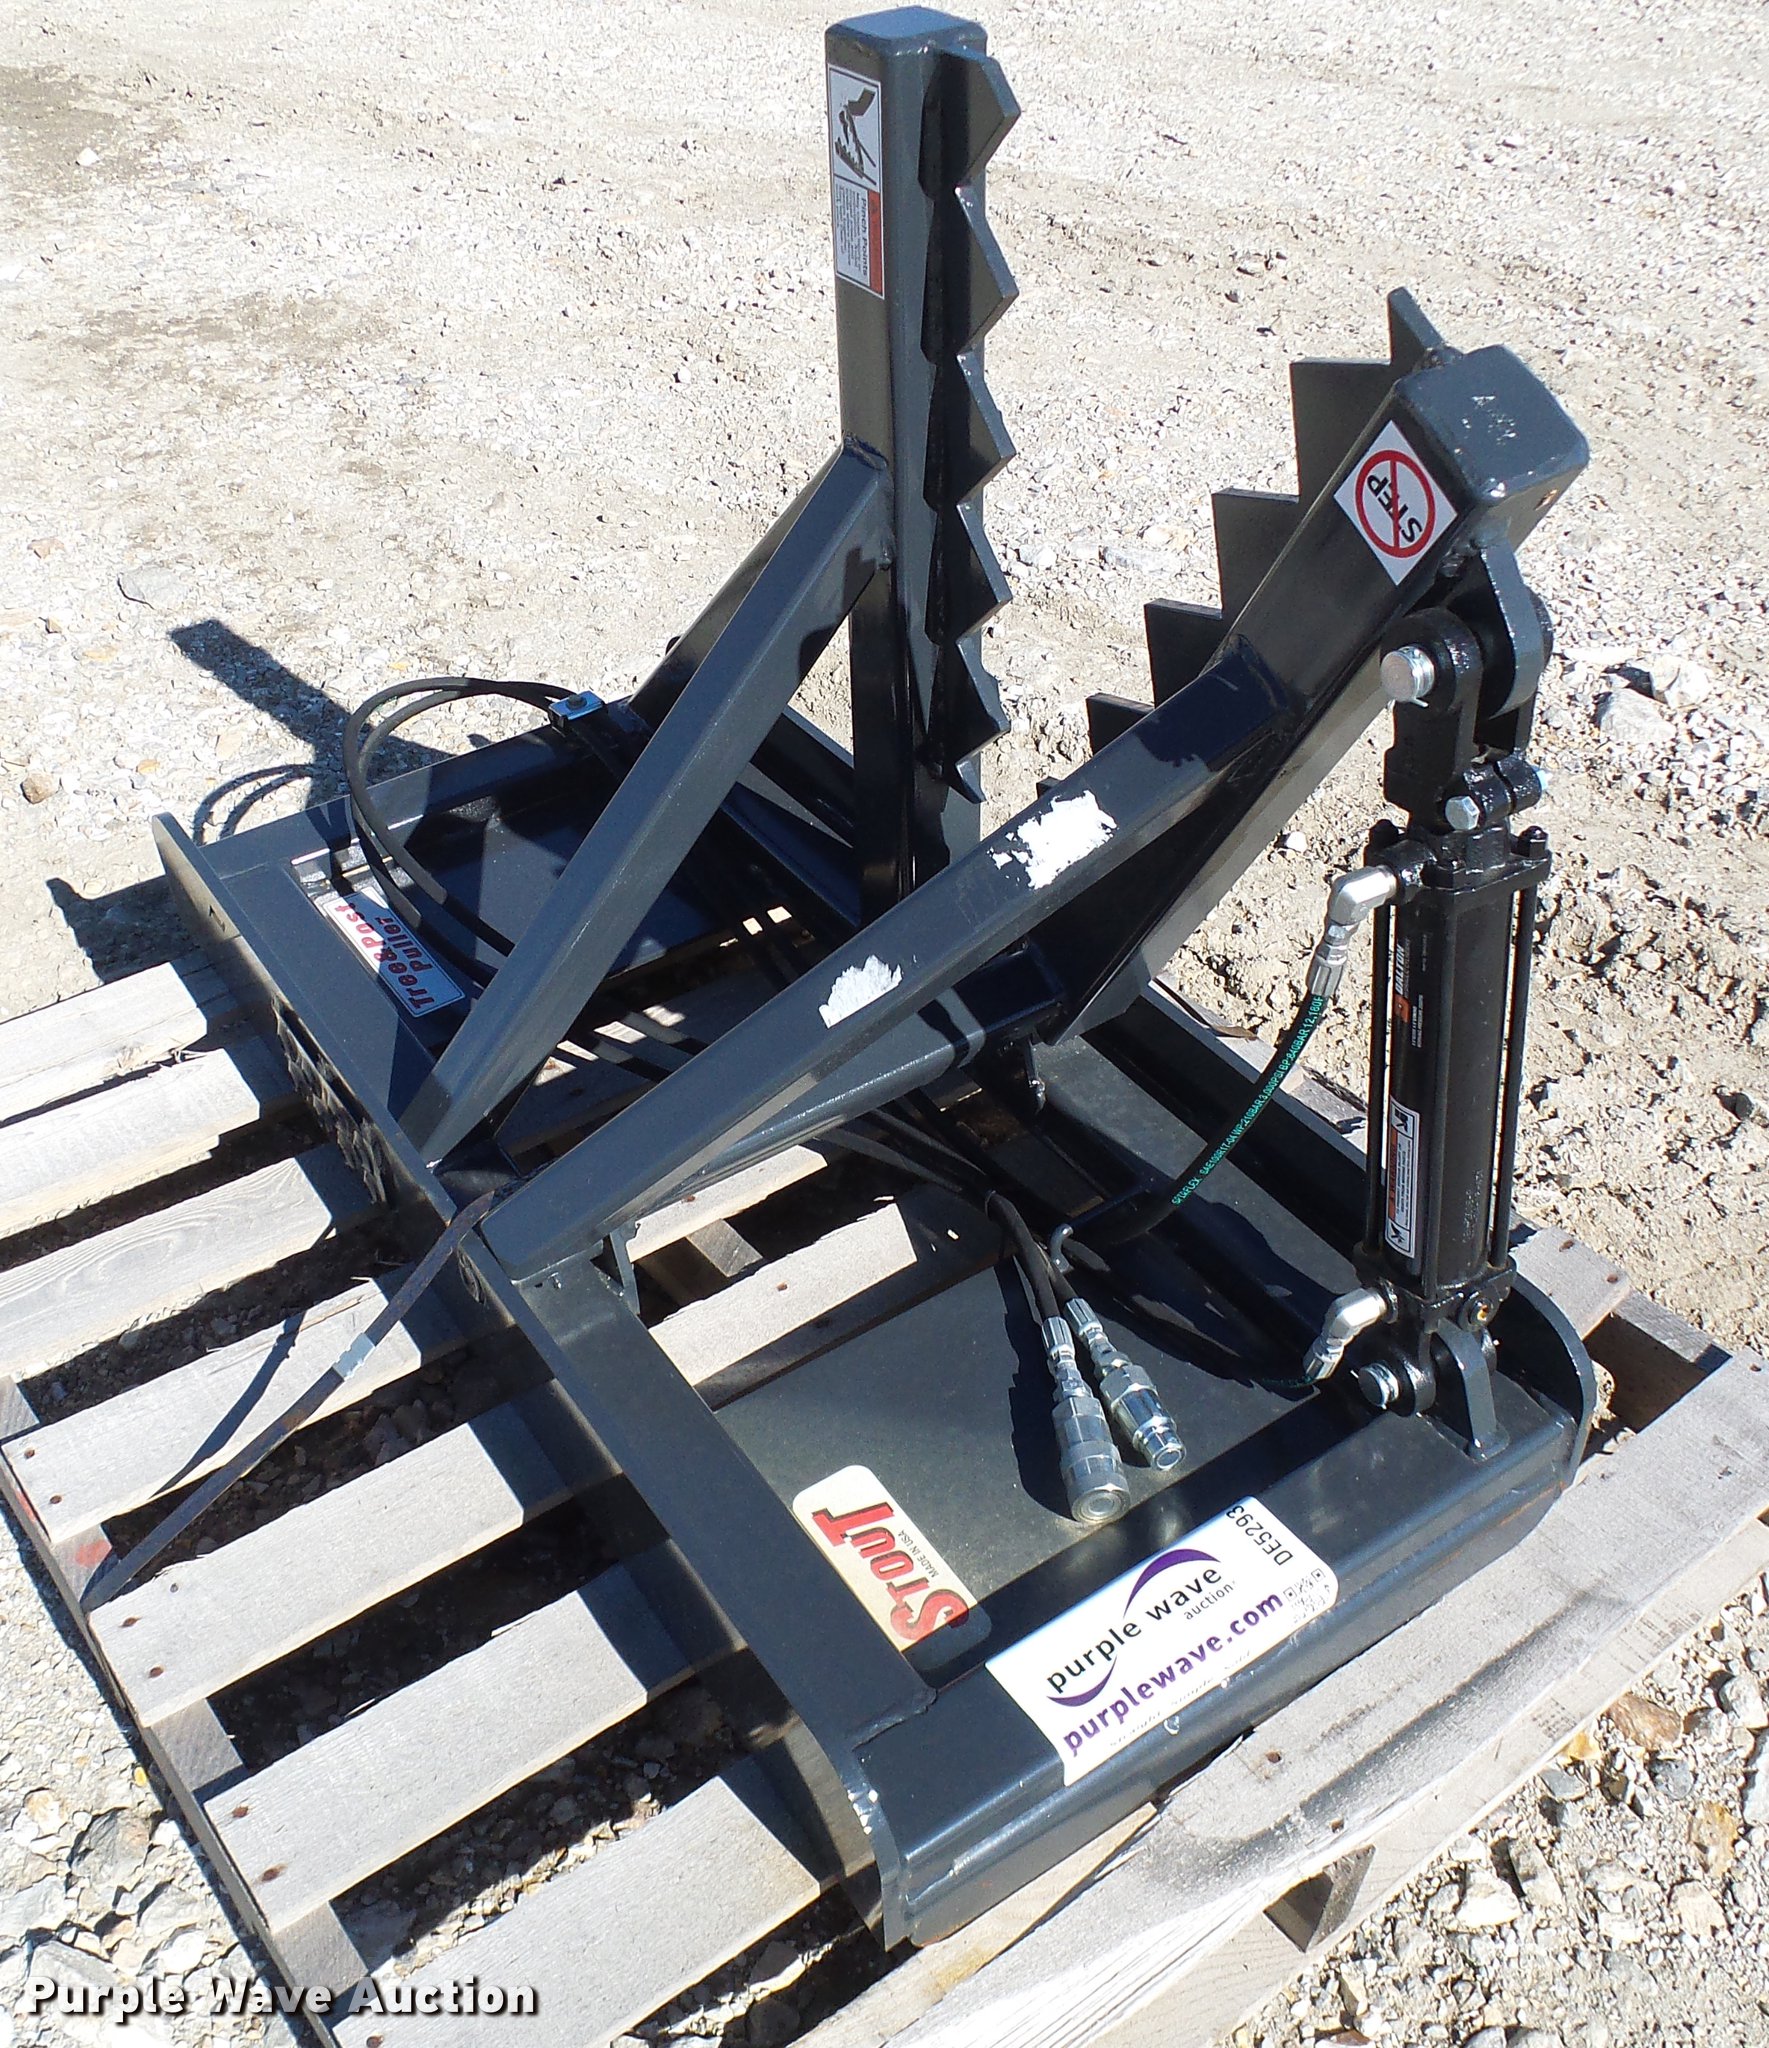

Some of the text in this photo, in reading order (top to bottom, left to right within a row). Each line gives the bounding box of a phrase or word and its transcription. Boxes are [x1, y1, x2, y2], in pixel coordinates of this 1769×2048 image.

[1366, 474, 1423, 543] STEP
[335, 902, 435, 1010] Tree&Post
[375, 917, 433, 972] Puller
[1395, 943, 1405, 996] DALTON
[897, 1529, 914, 1547] USA
[1226, 1504, 1294, 1566] DE5293
[916, 1555, 939, 1578] MADE
[1183, 1582, 1234, 1621] auction
[1046, 1621, 1142, 1694] purple
[1145, 1568, 1222, 1621] wave
[1063, 1591, 1284, 1757] purplewave.com
